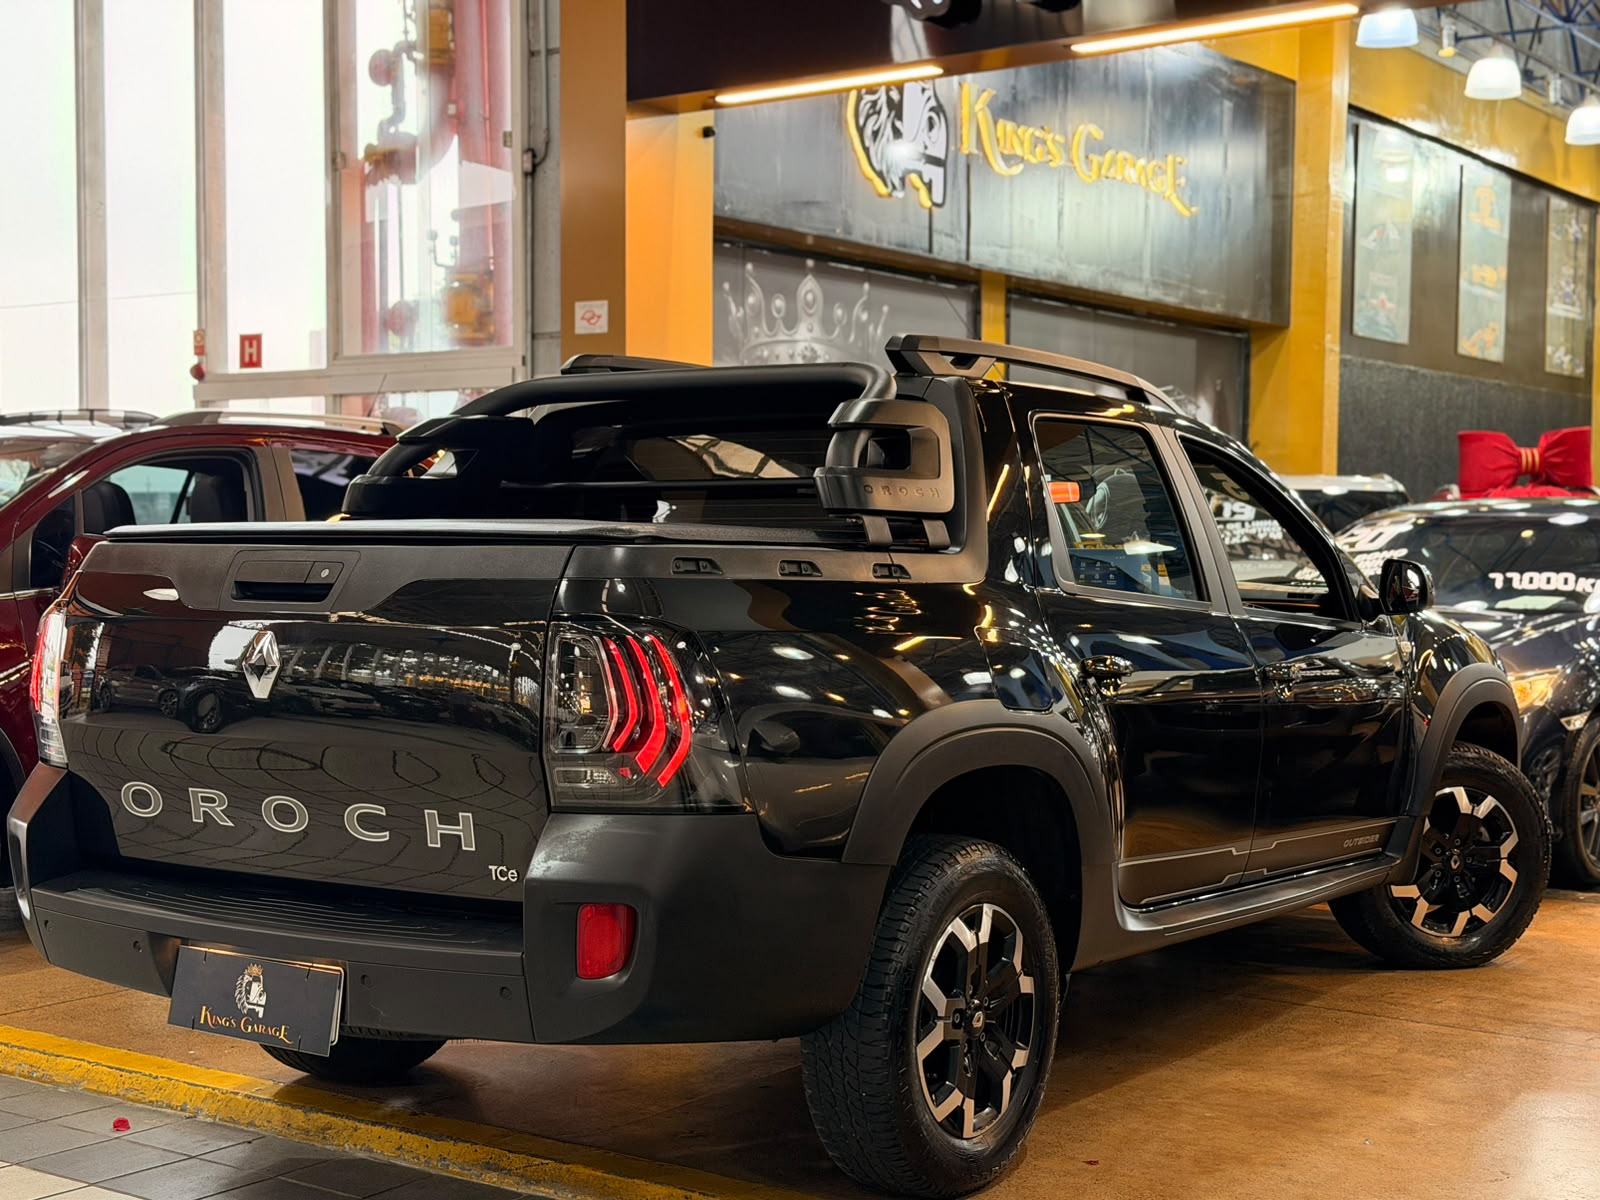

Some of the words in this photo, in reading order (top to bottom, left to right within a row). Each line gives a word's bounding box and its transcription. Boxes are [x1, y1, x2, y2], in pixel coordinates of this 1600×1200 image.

[243, 338, 258, 364] H
[120, 781, 477, 852] OROCH
[1343, 834, 1380, 848] OUTSIDER
[488, 865, 518, 882] TCe
[200, 1004, 237, 1030] KING'S
[240, 1016, 294, 1045] GARAGE
